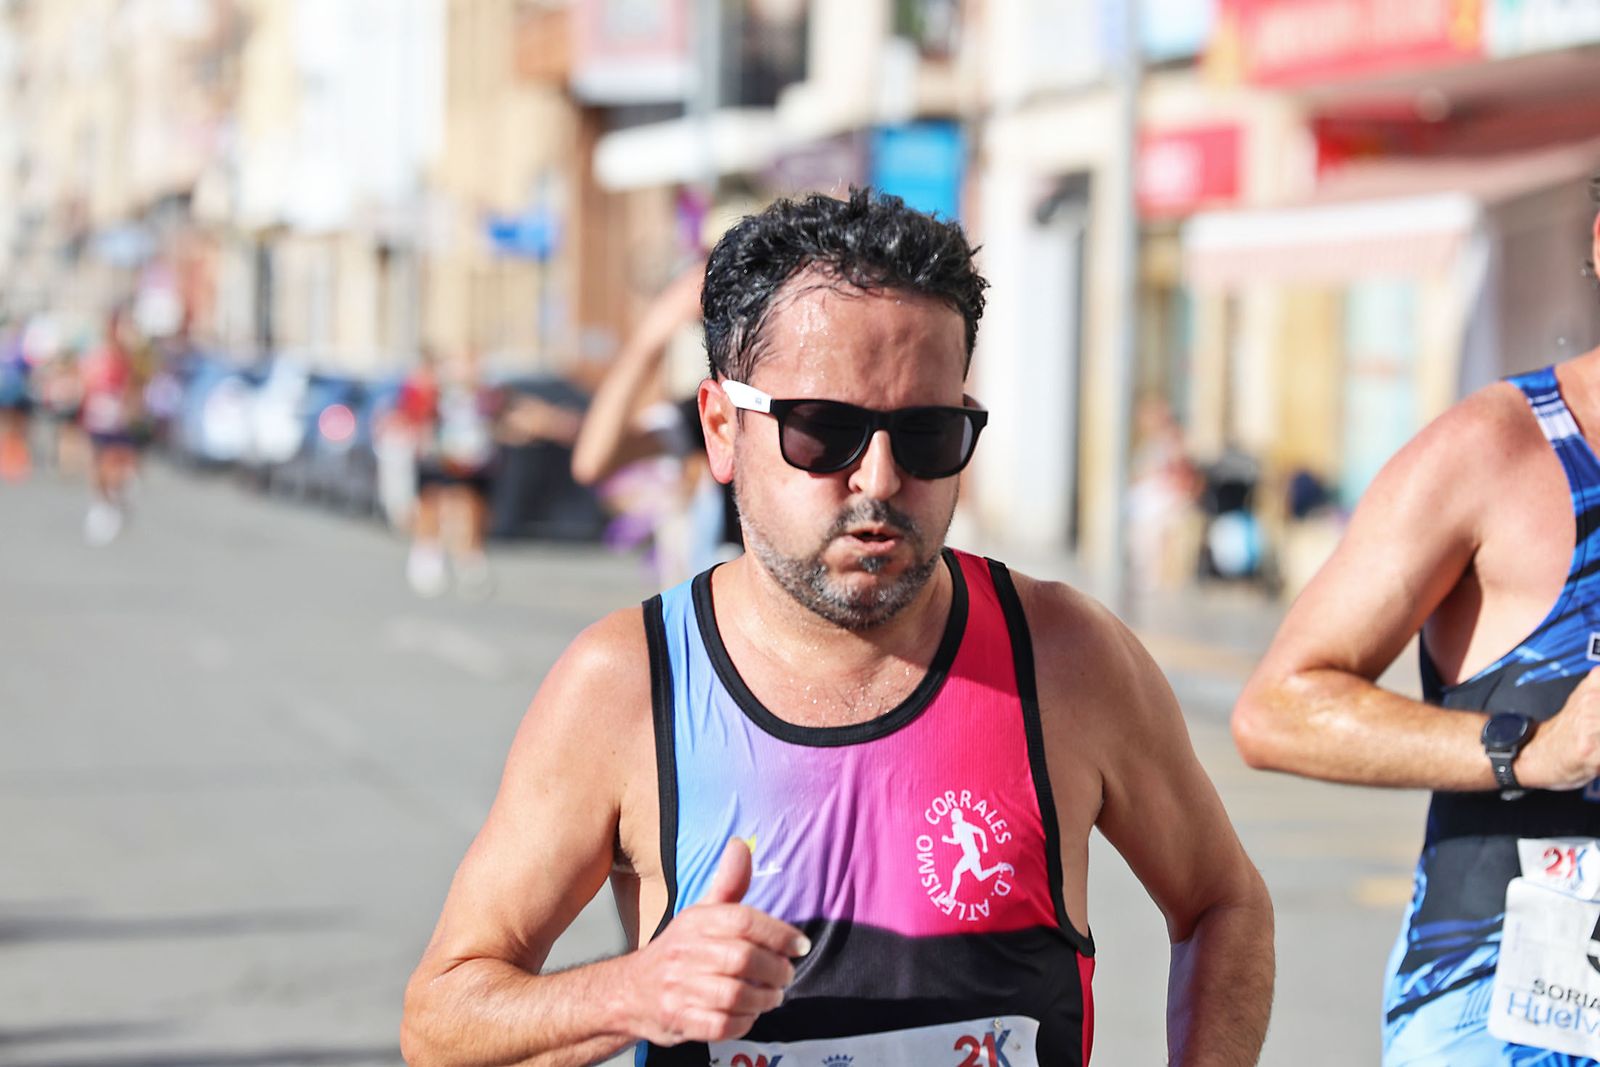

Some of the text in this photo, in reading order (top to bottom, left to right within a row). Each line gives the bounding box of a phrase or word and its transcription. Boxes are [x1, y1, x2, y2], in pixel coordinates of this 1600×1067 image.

[924, 789, 1012, 844] CORRALES
[916, 834, 990, 921] ATLETISMO
[1543, 847, 1587, 881] 21K
[954, 1028, 1011, 1067] 21K
